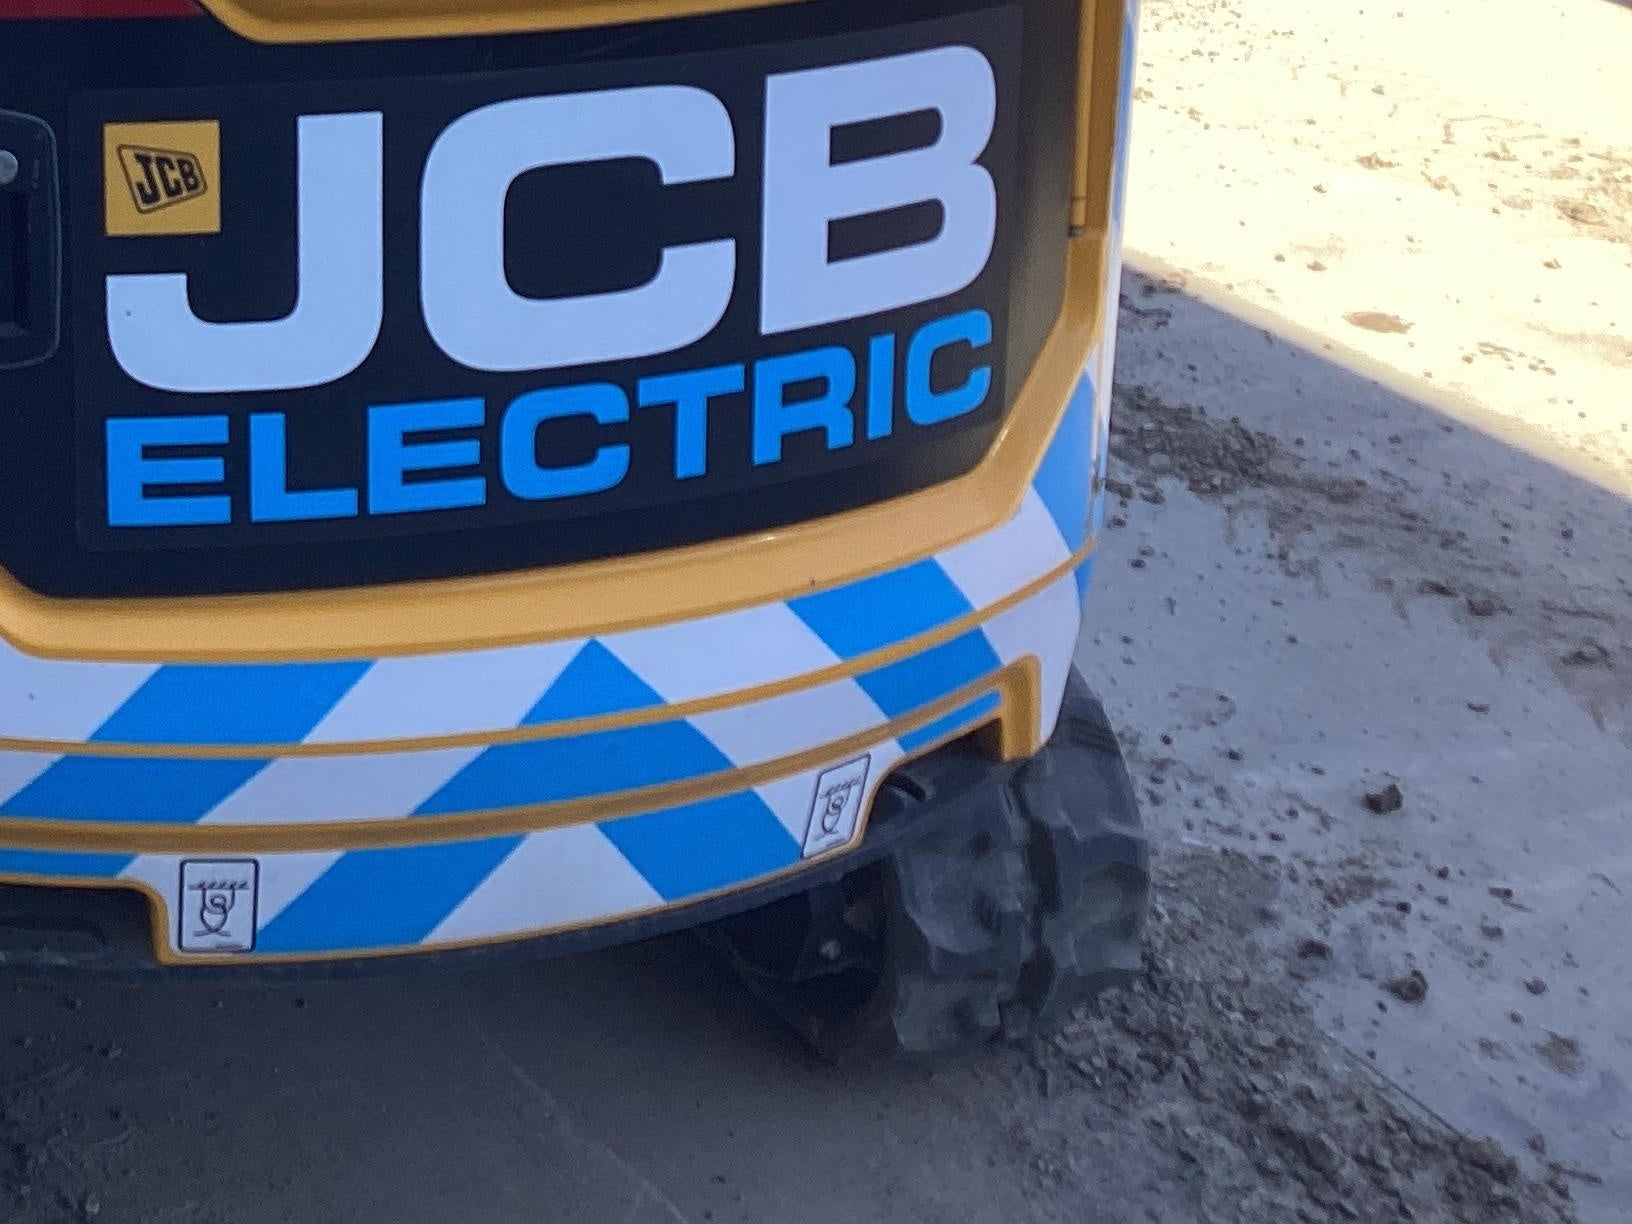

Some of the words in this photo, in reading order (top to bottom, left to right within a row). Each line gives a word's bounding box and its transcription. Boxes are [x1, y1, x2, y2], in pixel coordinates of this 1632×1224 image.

[106, 44, 997, 394] JCB
[133, 152, 201, 205] JCB
[105, 309, 993, 528] ELECTRIC
